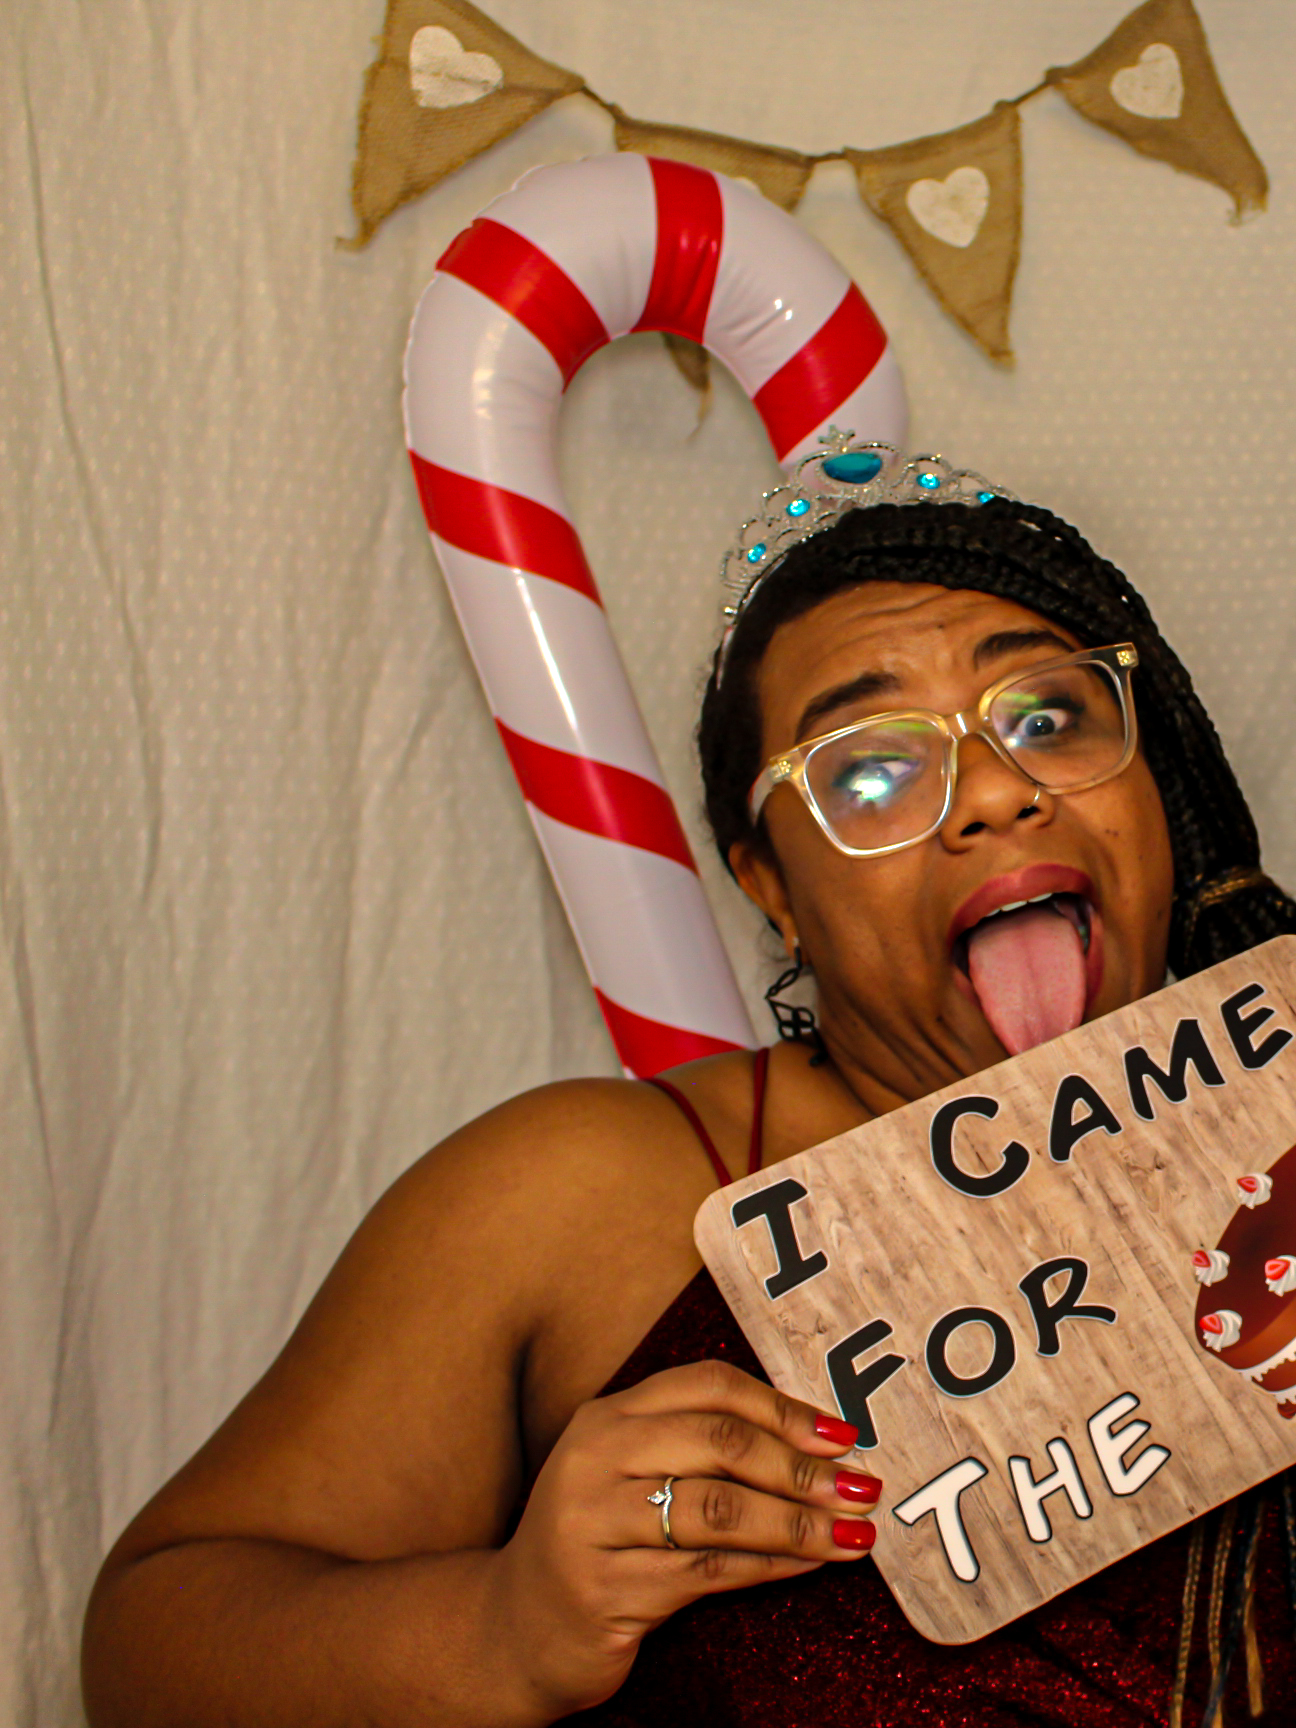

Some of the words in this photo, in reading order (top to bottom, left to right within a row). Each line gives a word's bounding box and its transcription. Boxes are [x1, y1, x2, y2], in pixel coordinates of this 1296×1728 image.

[732, 1178, 828, 1299] I
[929, 982, 1293, 1197] CAME
[825, 1256, 1116, 1449] FOR
[892, 1391, 1171, 1582] THE
